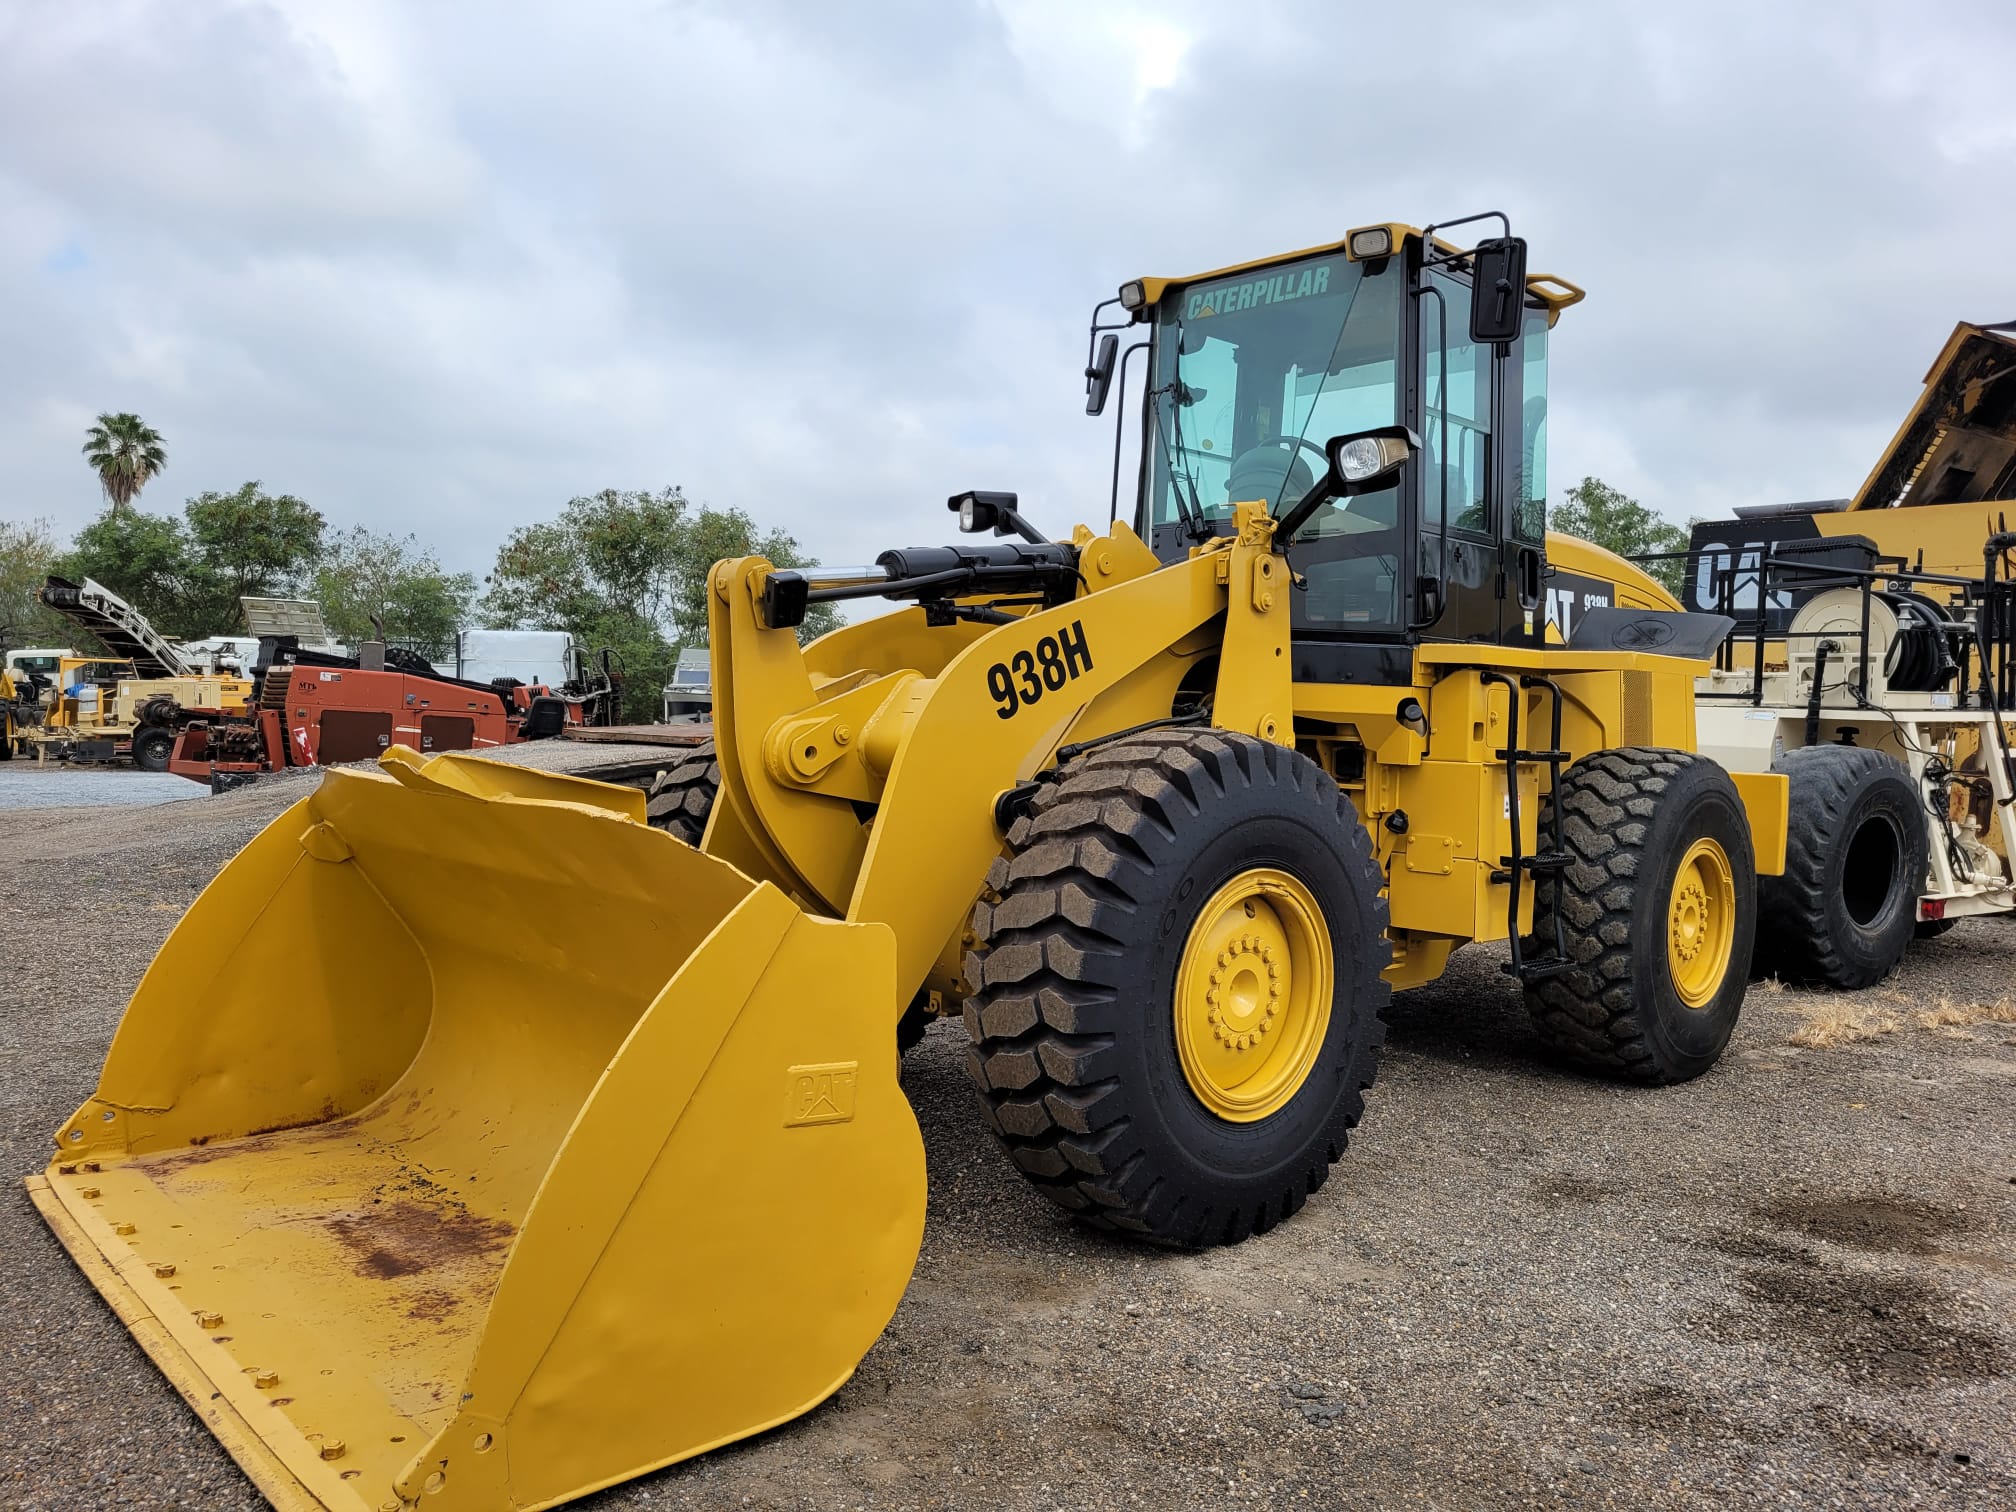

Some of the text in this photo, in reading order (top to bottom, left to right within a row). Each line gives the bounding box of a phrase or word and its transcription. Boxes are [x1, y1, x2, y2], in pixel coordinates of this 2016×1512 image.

[1187, 266, 1330, 320] CATERPILLAR
[1696, 542, 1793, 609] CA
[1545, 588, 1575, 644] AT
[987, 619, 1094, 720] 938H
[796, 1072, 853, 1118] CAT
